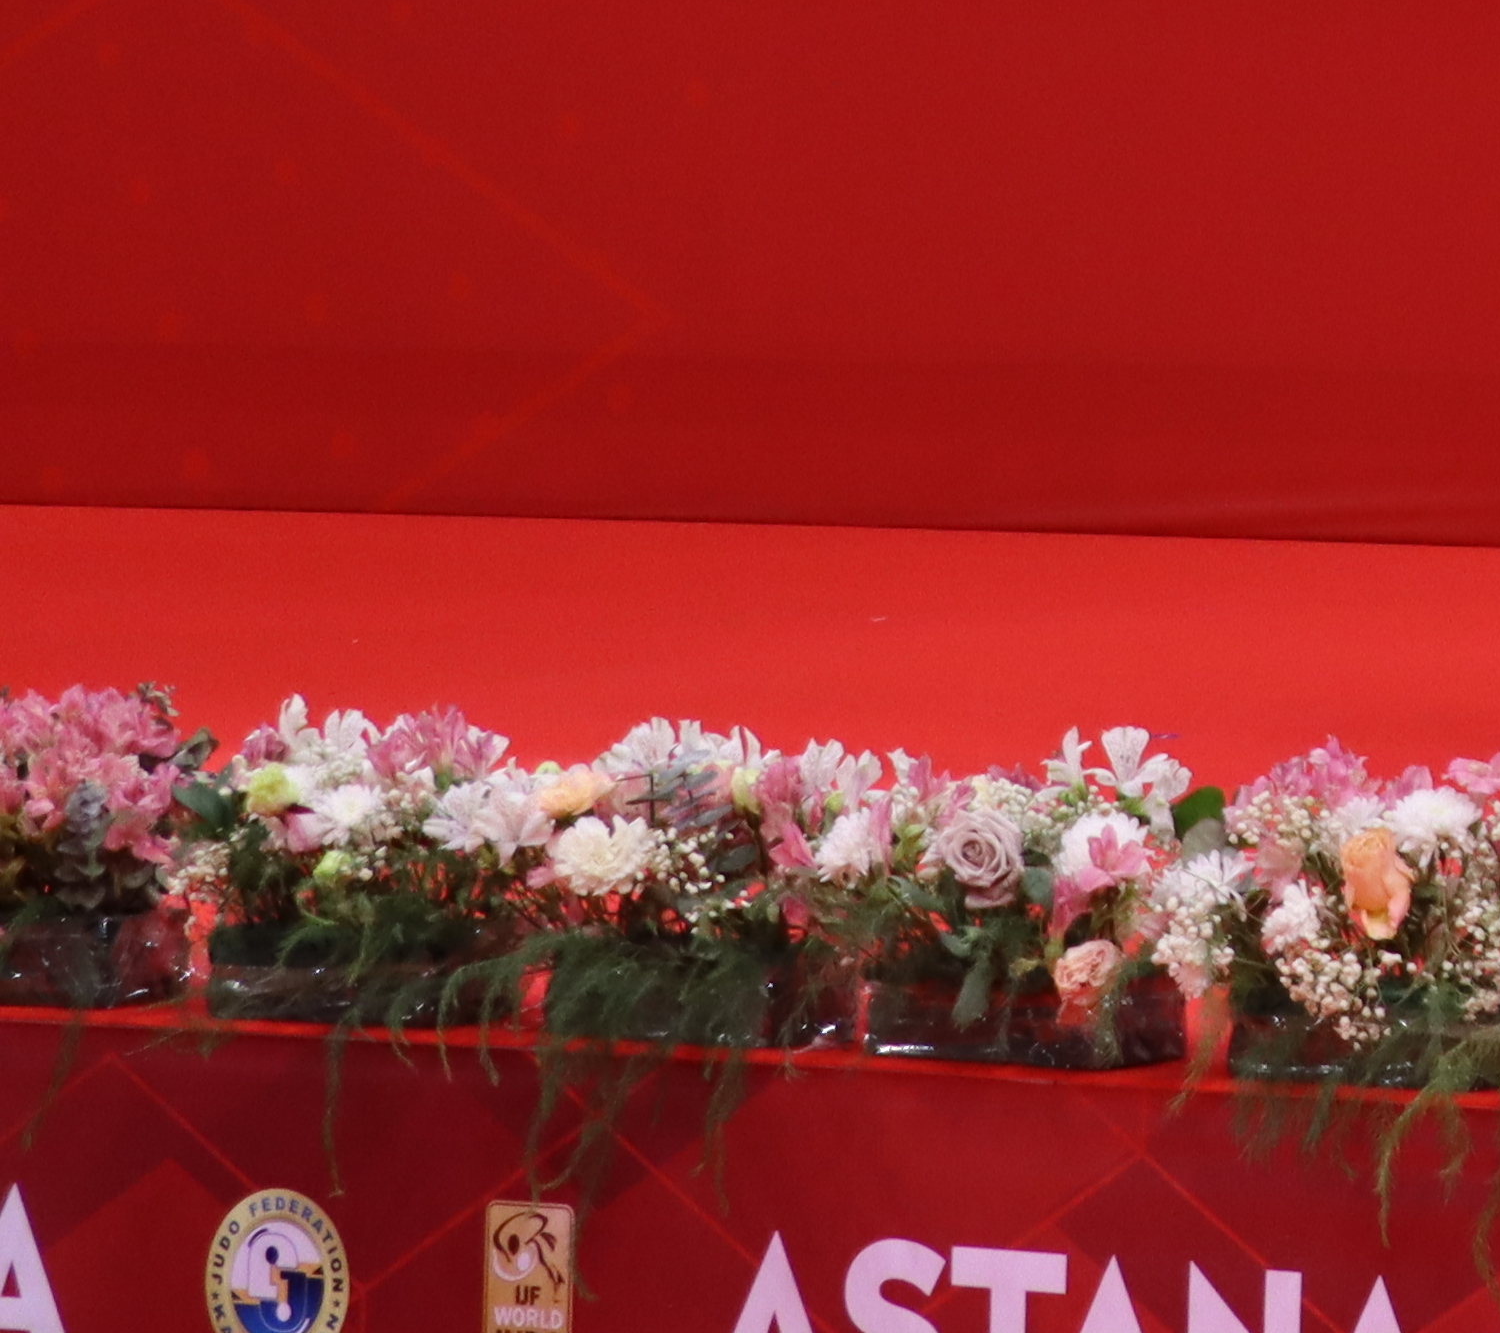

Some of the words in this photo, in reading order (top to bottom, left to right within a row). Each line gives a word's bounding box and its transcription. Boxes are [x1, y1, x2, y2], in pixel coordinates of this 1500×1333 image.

[213, 1220, 240, 1284] JUDO
[249, 1196, 344, 1294] FEDERATION
[515, 1286, 540, 1304] IJF
[493, 1306, 563, 1328] WORLD
